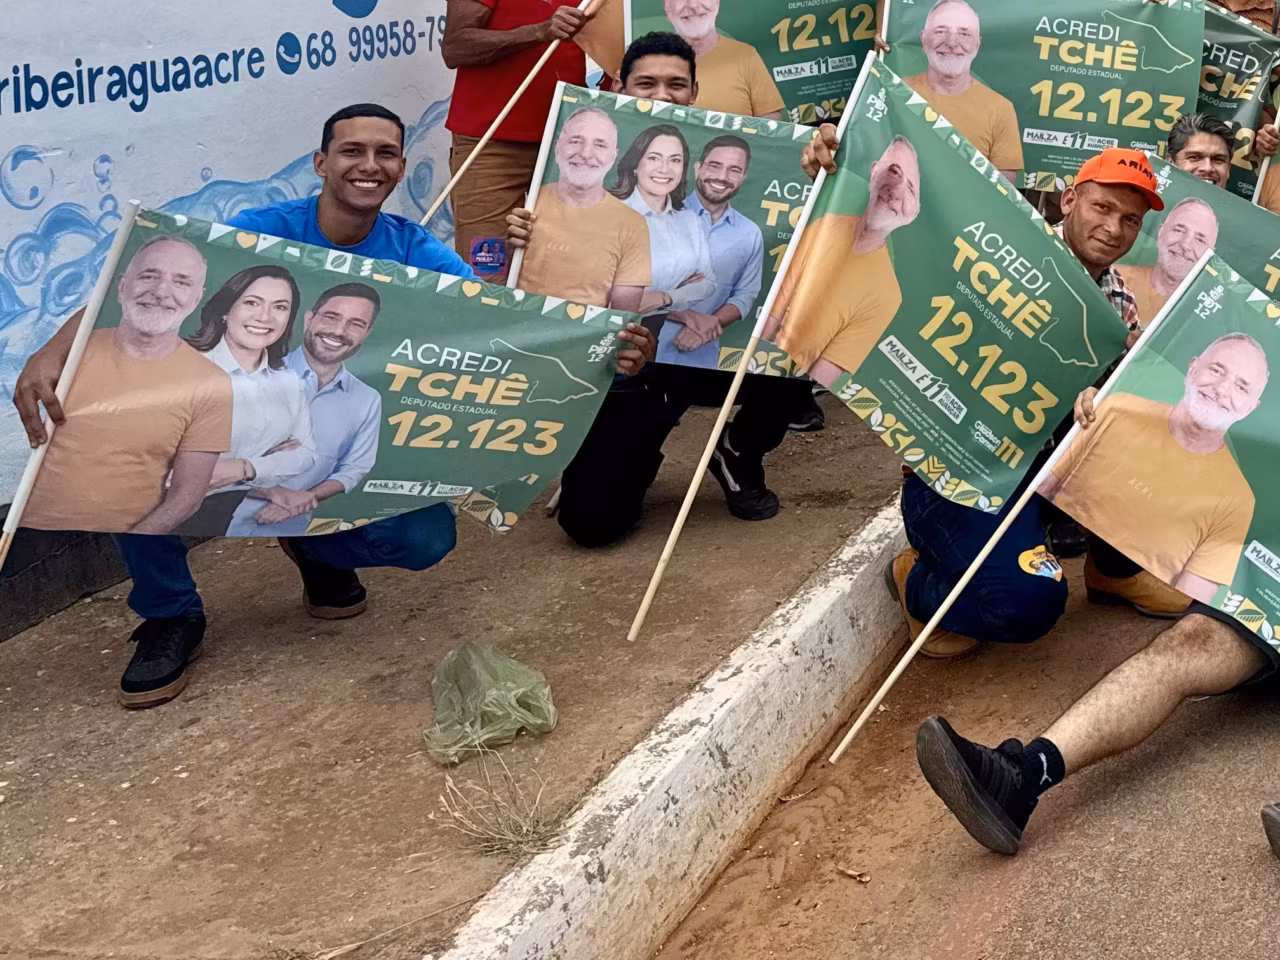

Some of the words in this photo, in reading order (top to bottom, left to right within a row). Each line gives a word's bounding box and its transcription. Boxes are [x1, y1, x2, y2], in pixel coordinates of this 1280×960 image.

[788, 1, 820, 9] DEPUTADO
[1035, 16, 1121, 42] ACREDI
[306, 31, 336, 69] 68
[1033, 36, 1139, 72] TCHÊ
[776, 66, 806, 78] MAILZA
[814, 57, 831, 74] 11
[1050, 64, 1087, 75] DEPUTADO
[1088, 68, 1123, 80] ESTADUAL
[864, 107, 882, 123] 12
[866, 94, 888, 115] PDT
[1030, 79, 1186, 131] 12.123
[1027, 132, 1058, 141] MAILZA
[1070, 132, 1088, 149] 11
[963, 221, 1052, 297] ACREDI
[953, 236, 1053, 339] TCHÊ
[956, 280, 987, 313] DEPUTADO
[983, 308, 1016, 340] ESTADUAL
[1194, 302, 1211, 320] 12
[1196, 292, 1224, 315] PDT
[391, 338, 512, 374] ACREDI
[588, 345, 616, 354] PDT
[588, 353, 604, 362] 12
[885, 340, 918, 374] MAILZA
[921, 376, 949, 400] 11
[919, 295, 1060, 435] 12.123
[385, 363, 529, 406] TCHÊ
[401, 396, 451, 411] DEPUTADO
[452, 405, 499, 415] ESTADUAL
[950, 397, 965, 414] ACRE
[388, 411, 565, 456] 12.123
[974, 420, 1001, 447] Gladson
[994, 436, 1025, 470] 111
[368, 482, 404, 490] MAILZA
[417, 482, 439, 496] 11
